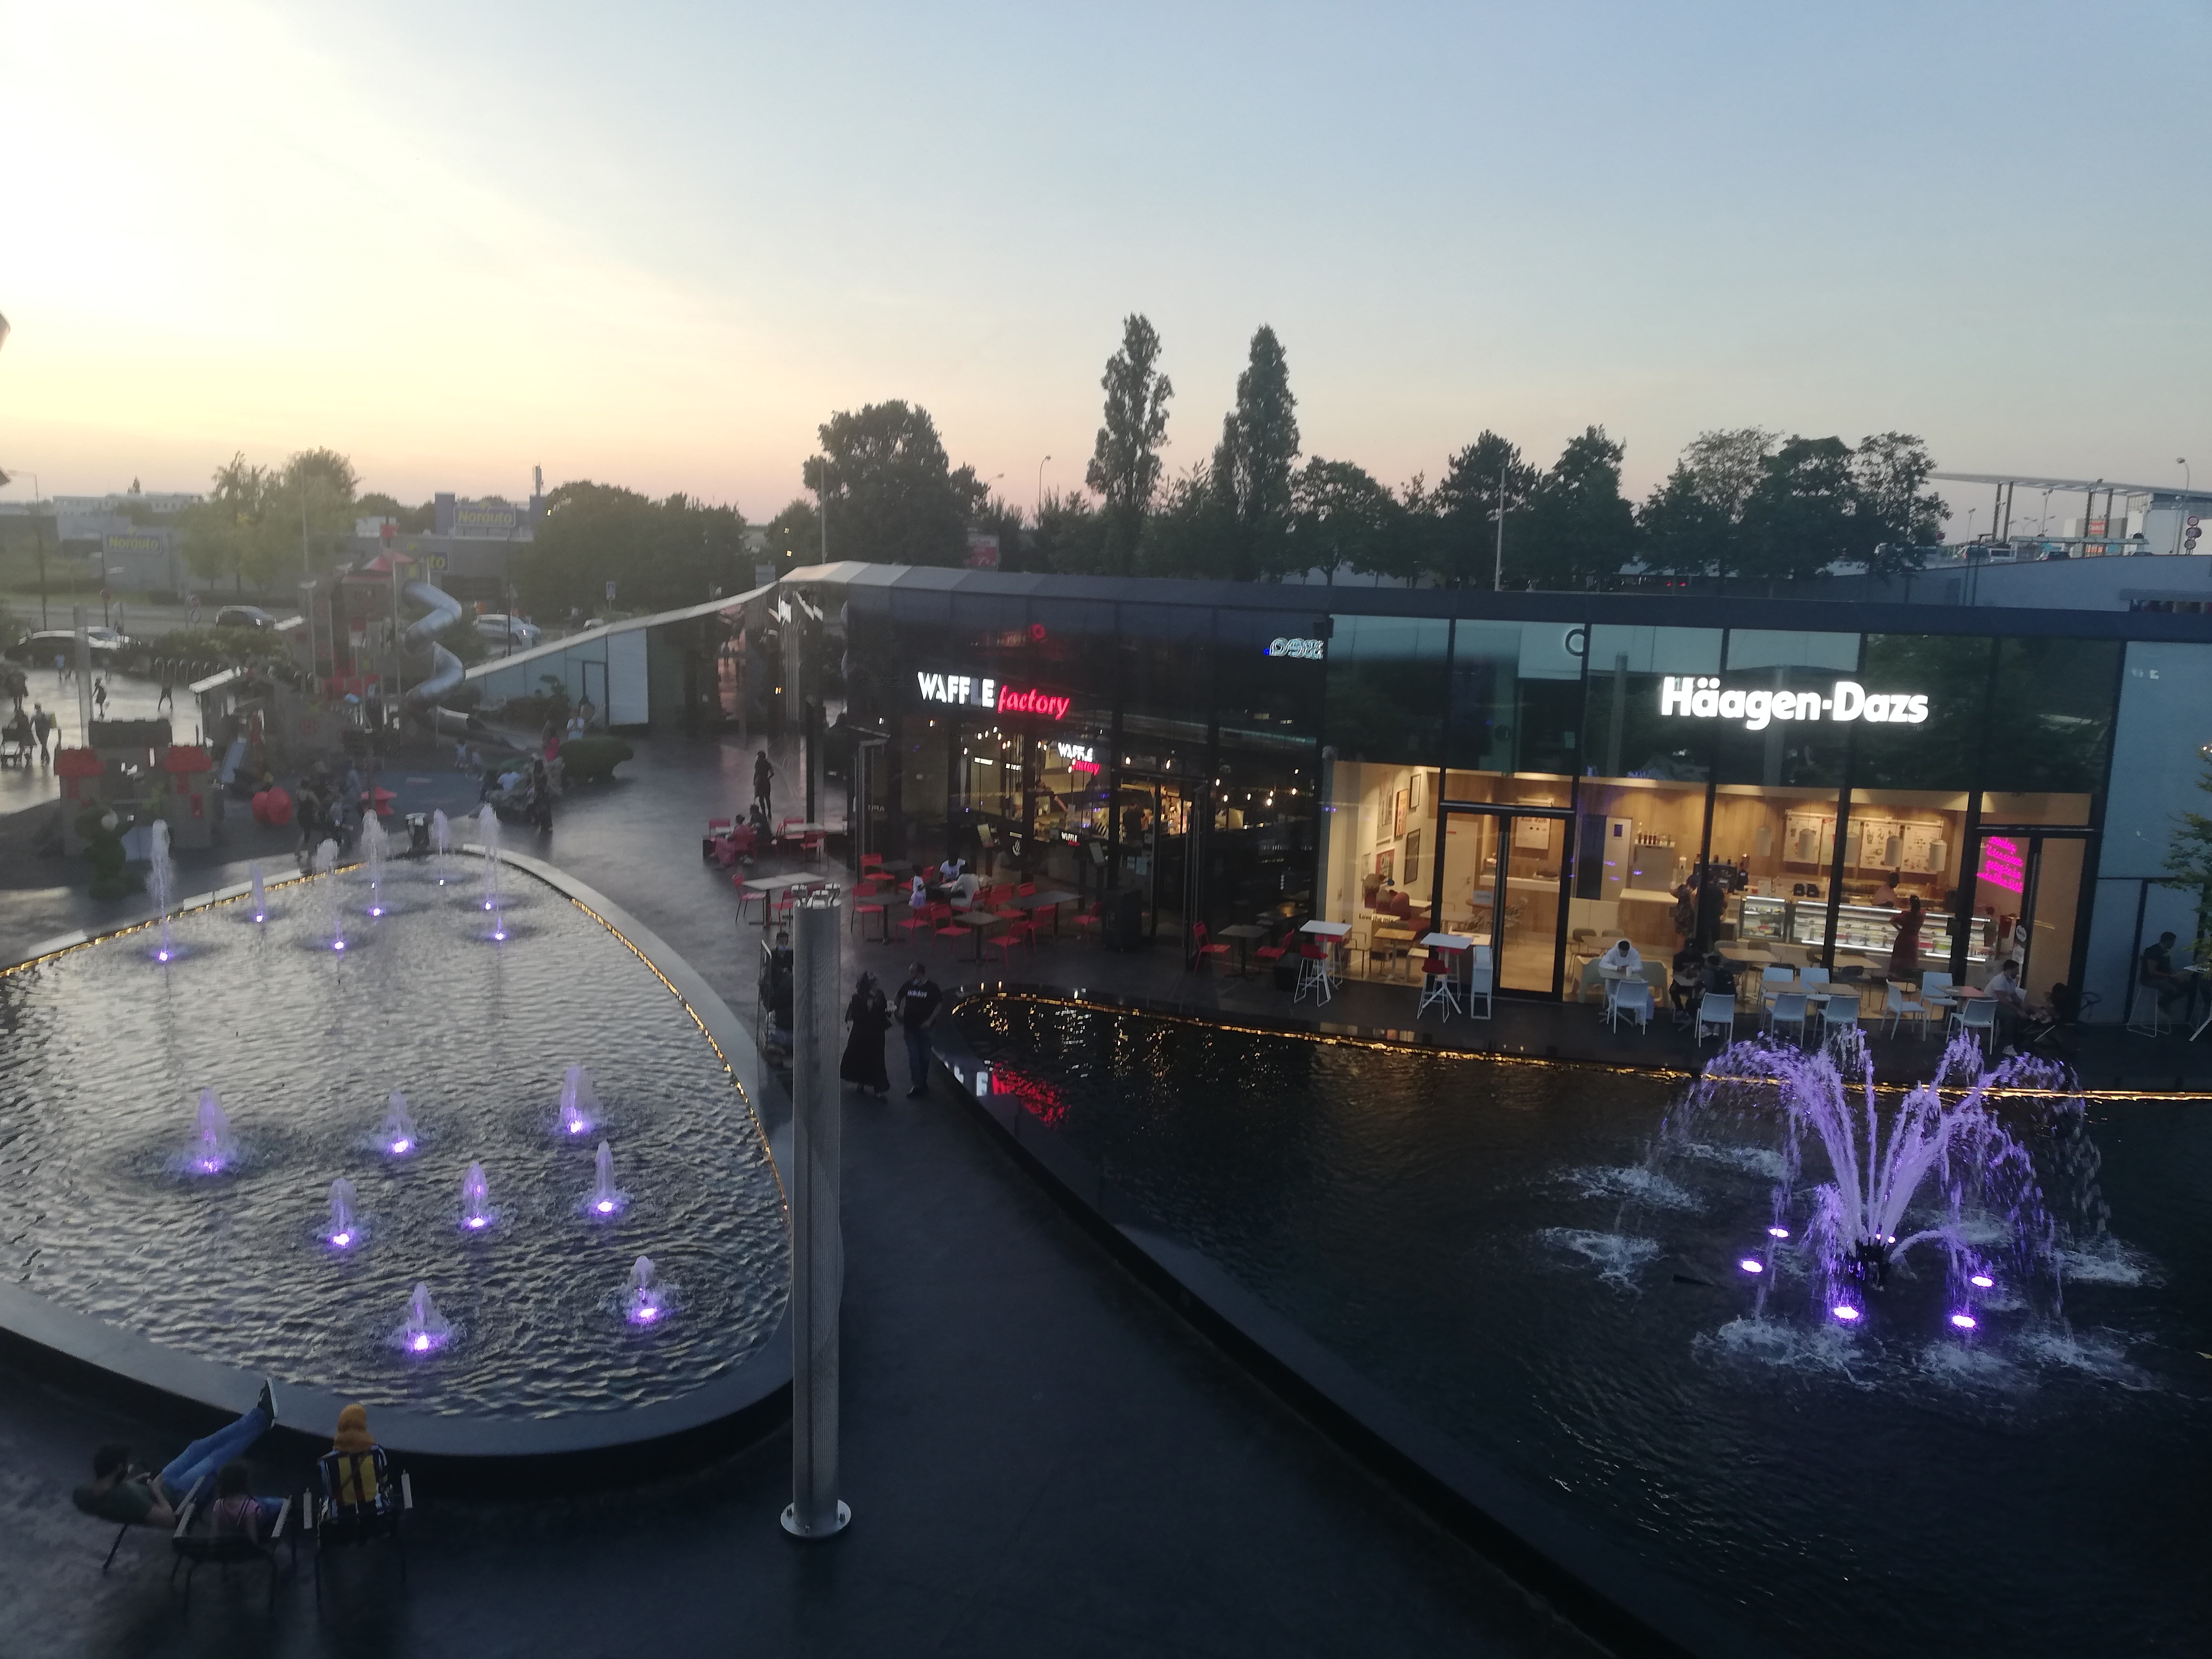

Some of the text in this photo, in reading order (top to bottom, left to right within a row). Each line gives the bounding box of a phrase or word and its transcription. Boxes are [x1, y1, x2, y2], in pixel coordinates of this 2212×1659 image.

[458, 510, 512, 524] Norauto
[108, 536, 158, 549] Norauto
[917, 672, 1070, 720] WAFFLE factory
[1661, 675, 1929, 731] Häagen-Dazs
[1058, 742, 1093, 762] WAFFLE
